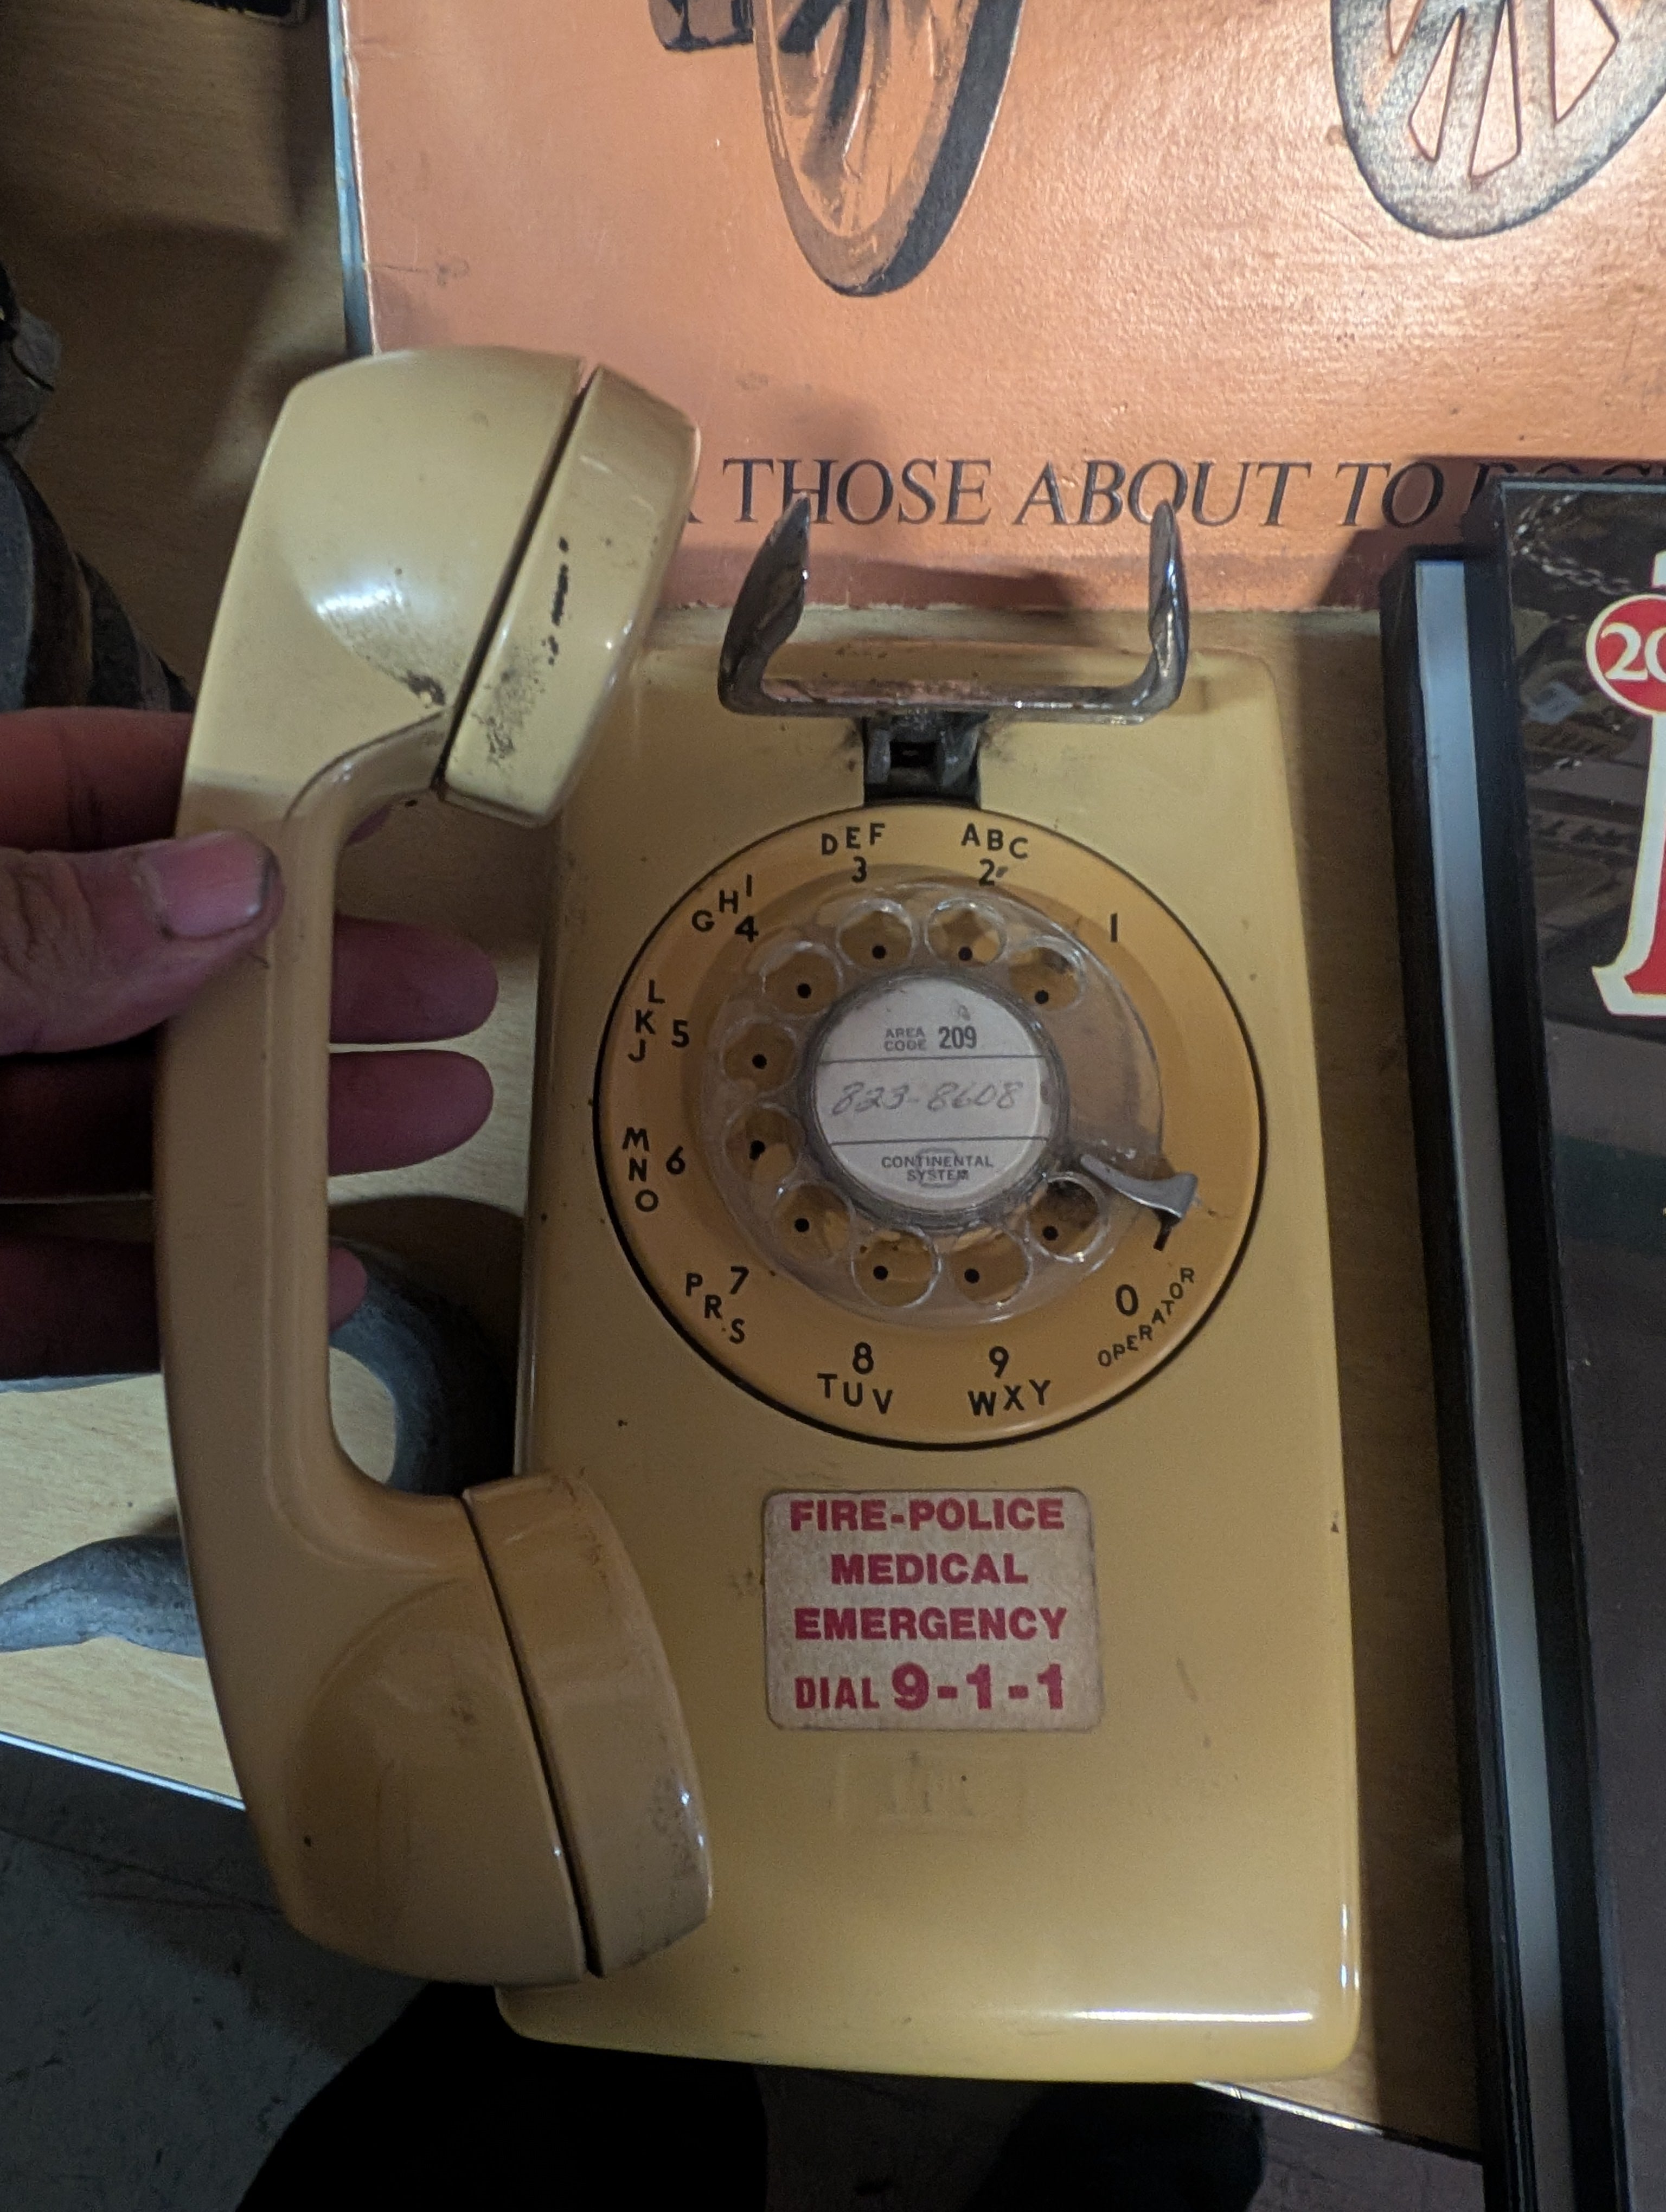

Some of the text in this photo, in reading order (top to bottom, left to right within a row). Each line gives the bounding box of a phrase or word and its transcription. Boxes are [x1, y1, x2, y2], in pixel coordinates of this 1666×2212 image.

[722, 459, 991, 525] THOSE
[1013, 459, 1311, 528] ABOUT
[1336, 461, 1444, 528] TO
[822, 823, 885, 855] DEF
[961, 823, 1028, 859] ABC
[851, 856, 867, 883] 3
[979, 858, 995, 886] 2
[735, 916, 759, 943] 4
[671, 1019, 690, 1047] 5
[885, 1028, 925, 1039] AREA
[885, 1039, 927, 1052] CODE
[938, 1026, 977, 1050] 209
[666, 1146, 685, 1175] 6
[881, 1155, 994, 1168] CONTINENTAL
[907, 1168, 969, 1181] SYSTEM
[730, 1266, 749, 1295] 7
[1098, 1267, 1195, 1367] OPERATOR
[852, 1342, 874, 1374] 8
[989, 1346, 1009, 1378] 9
[790, 1497, 1065, 1531] FIRE-POLICE
[831, 1552, 1029, 1585] MEDICAL
[794, 1606, 1067, 1640] EMERGENCY
[794, 1661, 1065, 1711] DIAL 9-1-1
